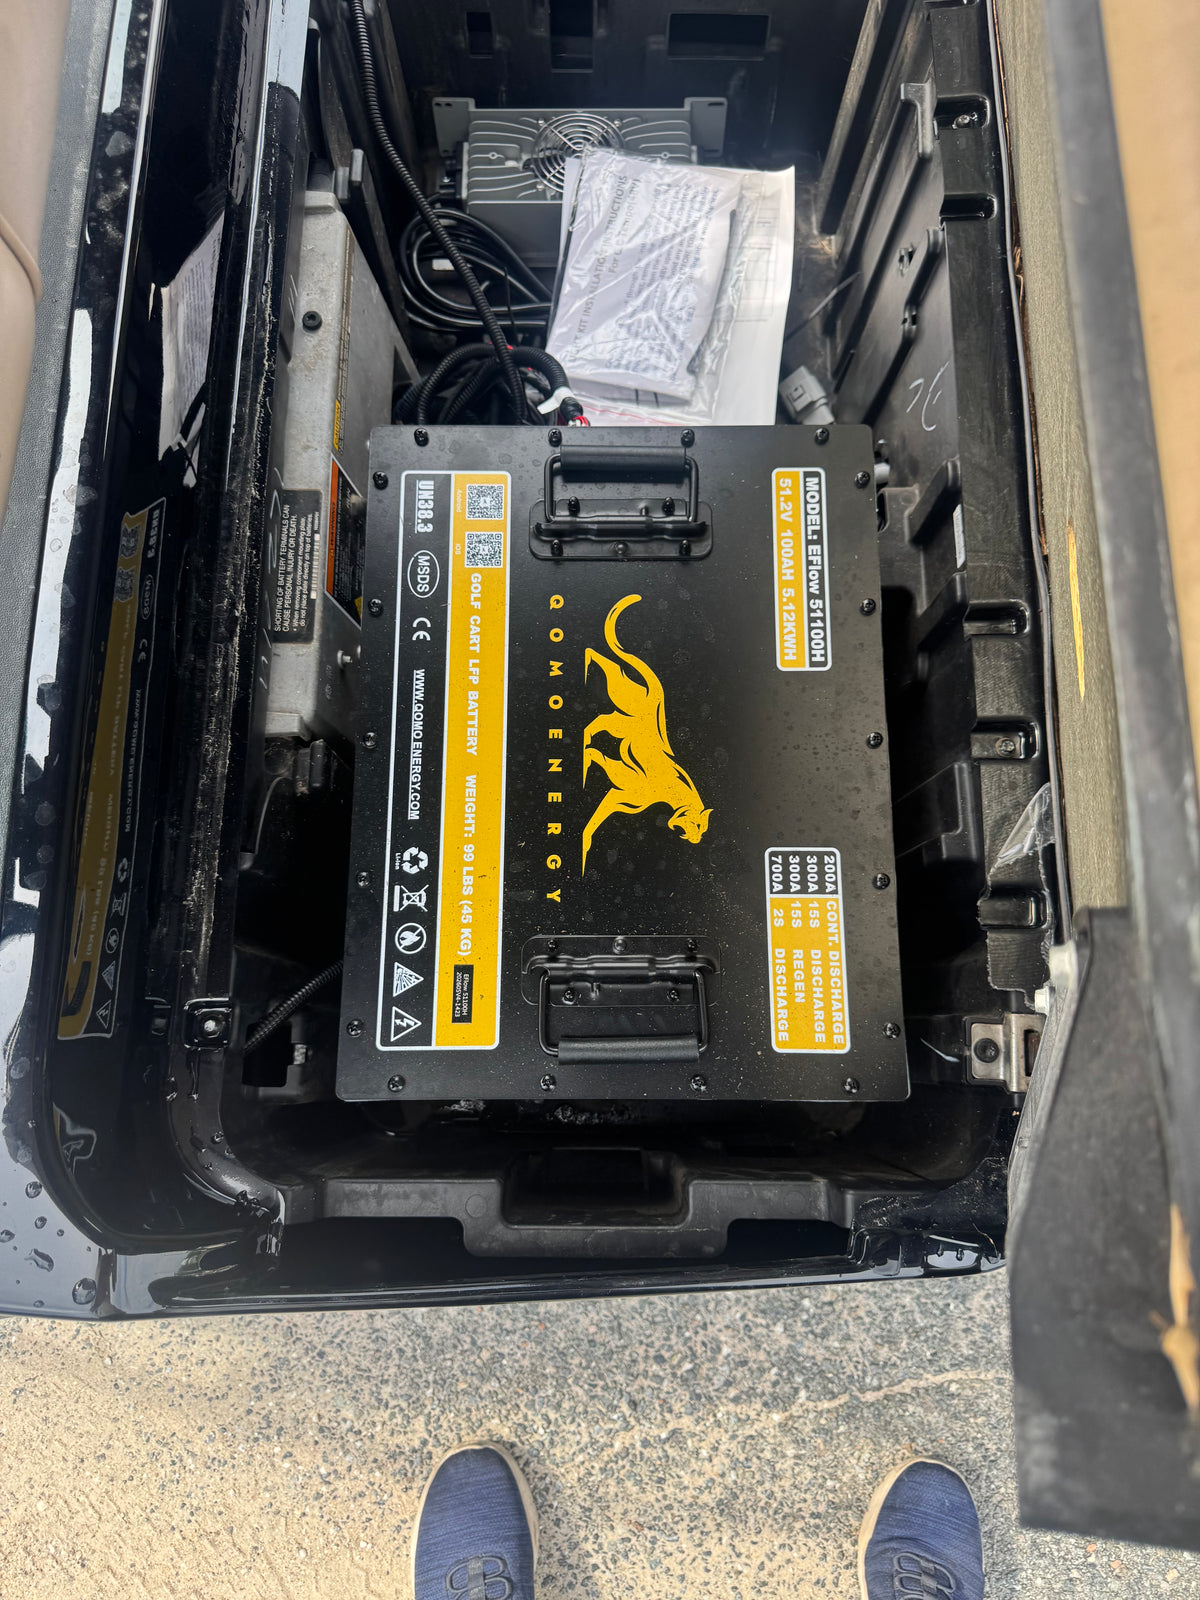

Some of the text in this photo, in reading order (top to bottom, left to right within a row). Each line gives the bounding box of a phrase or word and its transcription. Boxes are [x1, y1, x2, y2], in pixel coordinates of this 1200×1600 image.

[609, 260, 618, 274] For
[578, 319, 590, 337] KIT
[416, 480, 434, 533] UN38.3
[281, 520, 289, 556] TERMINALS
[288, 537, 295, 547] OR
[277, 586, 283, 596] OF
[285, 572, 293, 608] PERSONAL
[416, 555, 430, 592] MSDS
[780, 478, 796, 661] 51.2V 100AH 5.12KWH
[806, 477, 825, 662] MODEL: EFlow 51100H
[274, 597, 283, 631] SHORTING
[457, 573, 482, 956] GOLF CART LFP BATTERY WEIGHT: 99 LBS (45 KG)
[771, 855, 789, 1042] 700A 2S DISCHARGE
[789, 855, 805, 1003] 300A 15S REGEN
[806, 855, 825, 1043] 300A 15S DISCHARGE
[824, 855, 844, 1044] 200A CONT. DISCHARGE
